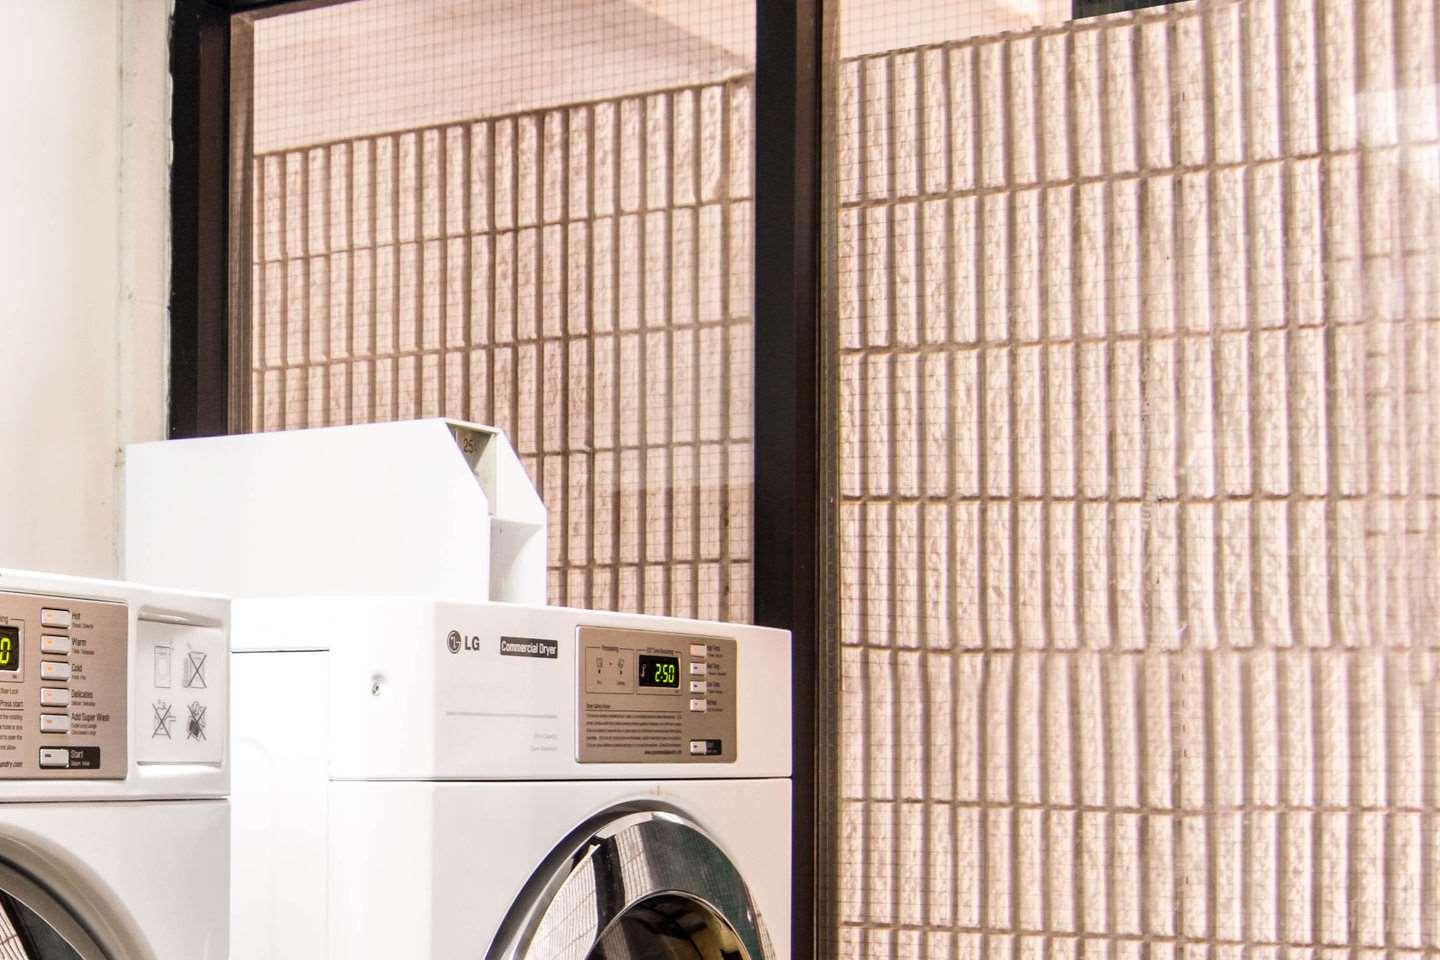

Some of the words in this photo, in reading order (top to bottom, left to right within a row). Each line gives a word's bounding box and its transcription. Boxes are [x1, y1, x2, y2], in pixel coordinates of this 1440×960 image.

[464, 636, 480, 651] LG
[501, 641, 538, 653] Commercial
[539, 643, 557, 656] Dryer
